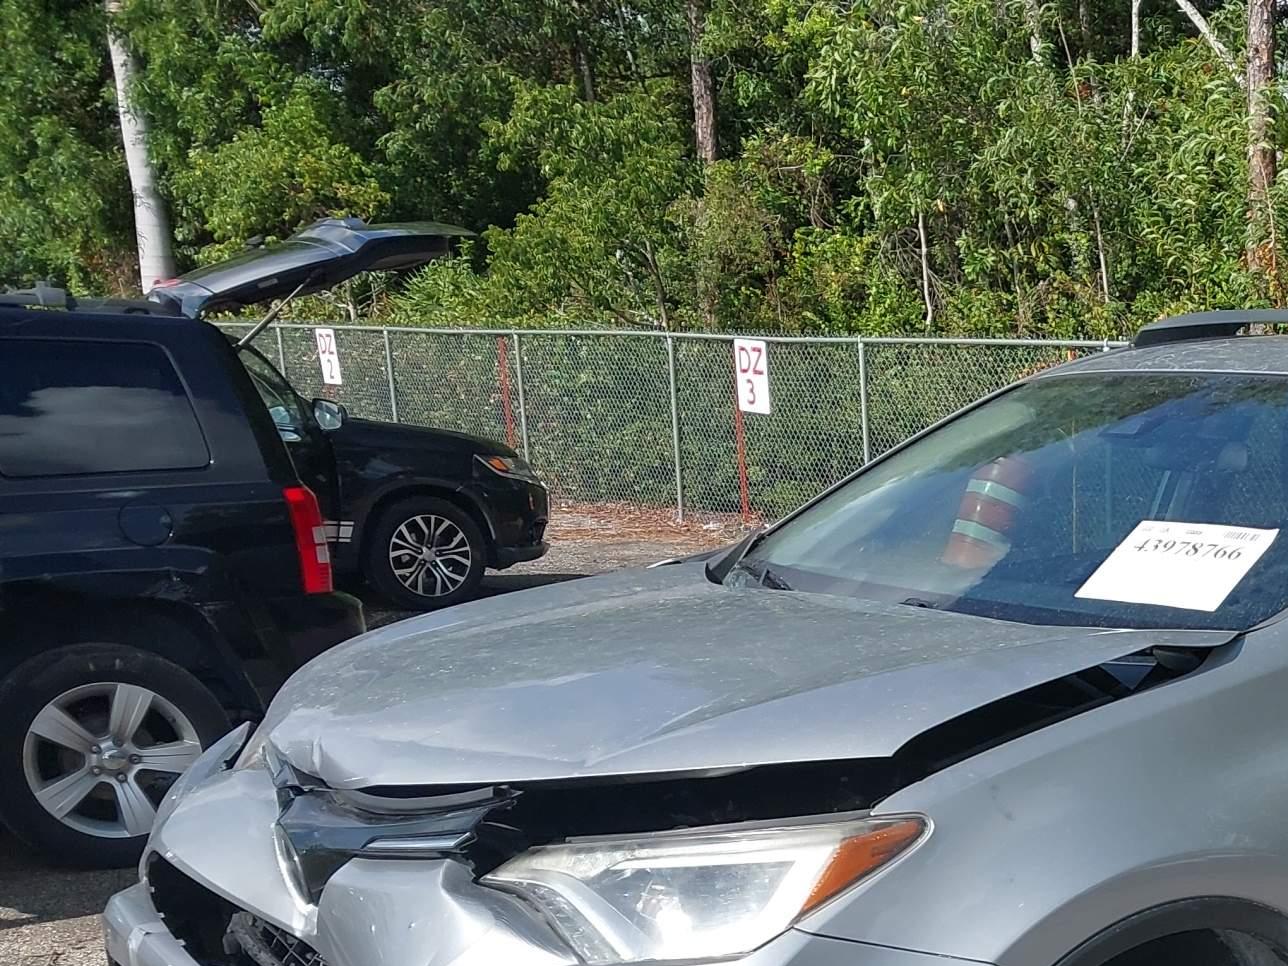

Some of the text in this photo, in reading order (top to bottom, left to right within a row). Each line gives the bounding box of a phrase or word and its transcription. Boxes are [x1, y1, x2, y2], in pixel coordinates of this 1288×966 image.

[318, 333, 335, 355] DZ
[327, 358, 335, 380] 2
[738, 345, 764, 375] DZ
[746, 379, 756, 405] 3
[1133, 537, 1245, 561] 43978766
